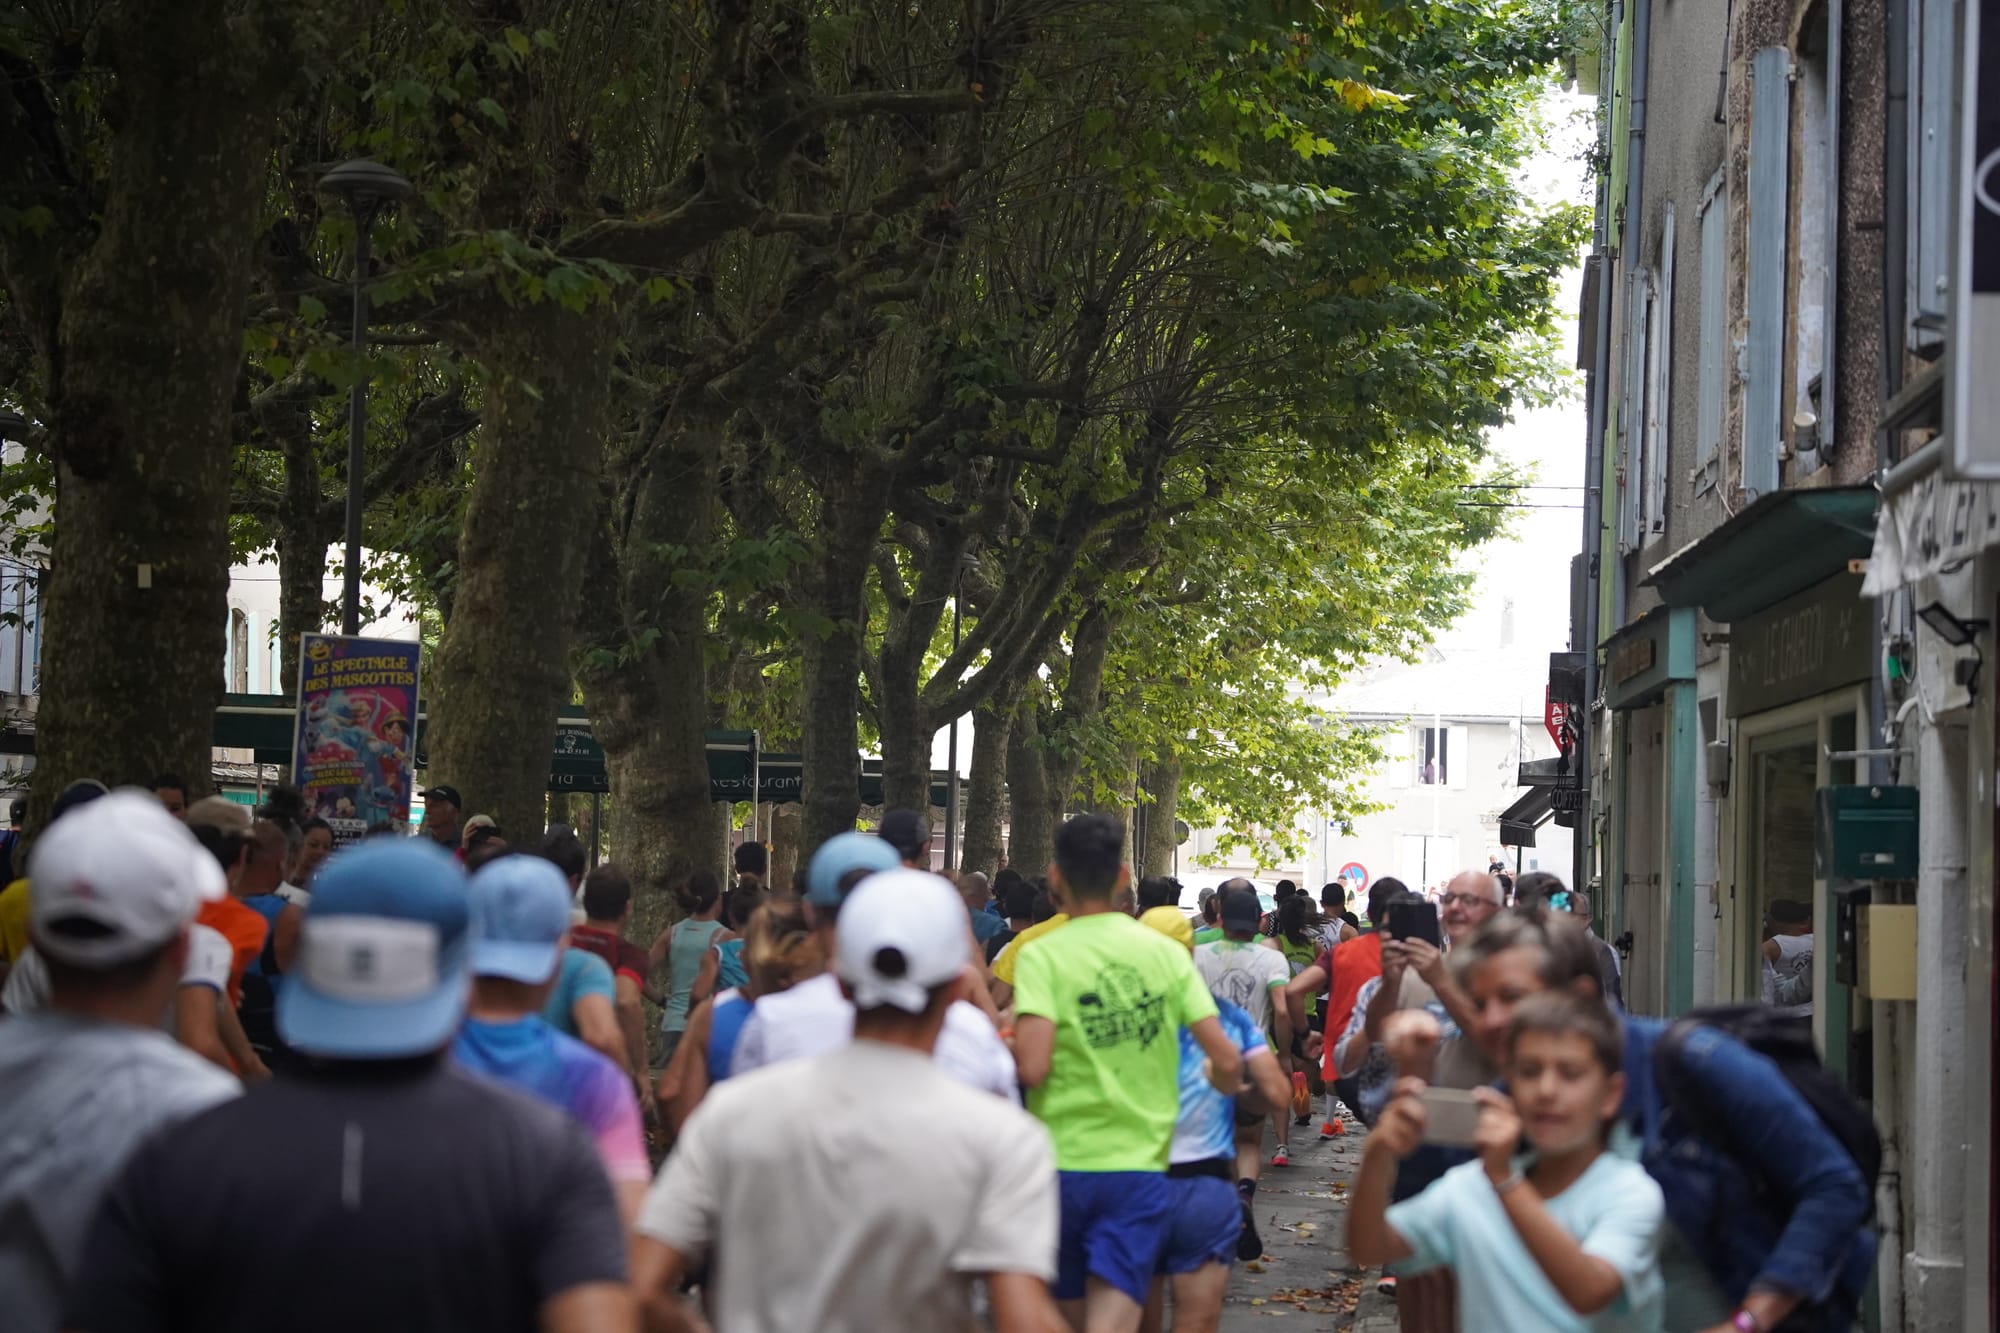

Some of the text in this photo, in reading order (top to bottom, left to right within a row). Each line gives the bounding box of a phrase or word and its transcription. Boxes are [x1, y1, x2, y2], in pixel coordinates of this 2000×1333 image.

[313, 656, 408, 676] LE SPECTACLE
[304, 672, 415, 692] DES MASCOTTES
